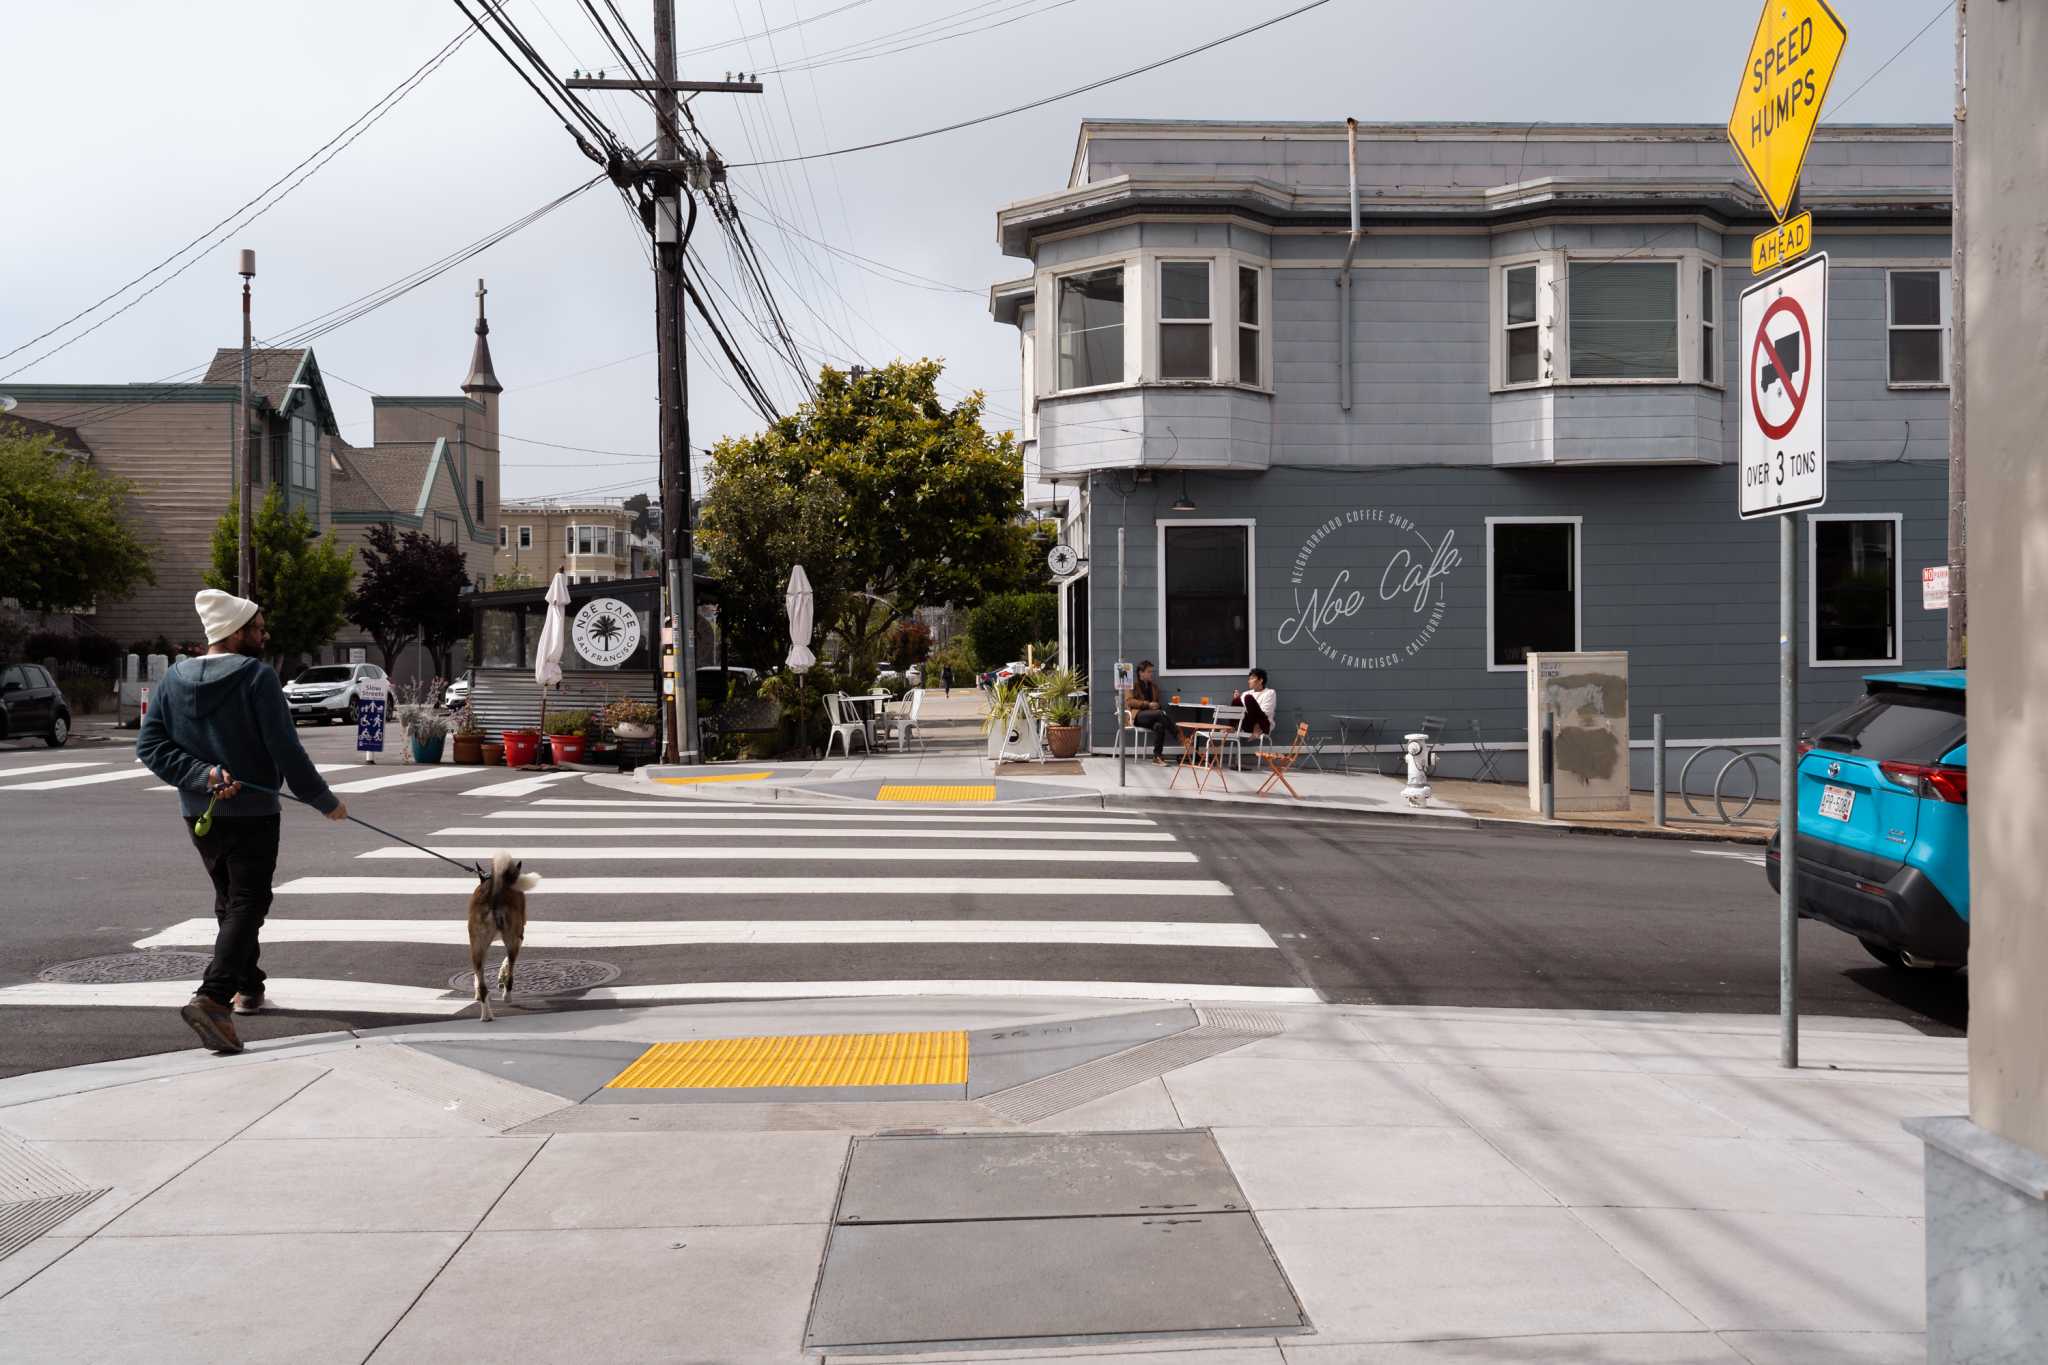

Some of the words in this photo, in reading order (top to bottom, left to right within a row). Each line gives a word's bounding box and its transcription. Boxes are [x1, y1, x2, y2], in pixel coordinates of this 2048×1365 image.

[1753, 17, 1813, 93] SPEED
[1751, 68, 1816, 148] HUMPS
[1758, 224, 1804, 265] AHEAD
[1746, 462, 1770, 488] OVER
[1776, 450, 1785, 486] 3
[1790, 450, 1816, 477] TONS
[1291, 516, 1342, 584] NEIGHBORHOOD
[1346, 509, 1384, 523] COFFEE
[1388, 513, 1415, 531] SHOP
[605, 602, 636, 629] CAFE
[1278, 569, 1365, 644] Noe
[1318, 642, 1338, 660] SAN
[1406, 602, 1446, 656] CALIFORNIA
[578, 636, 590, 654] SAN
[591, 635, 635, 662] FRANCISCO
